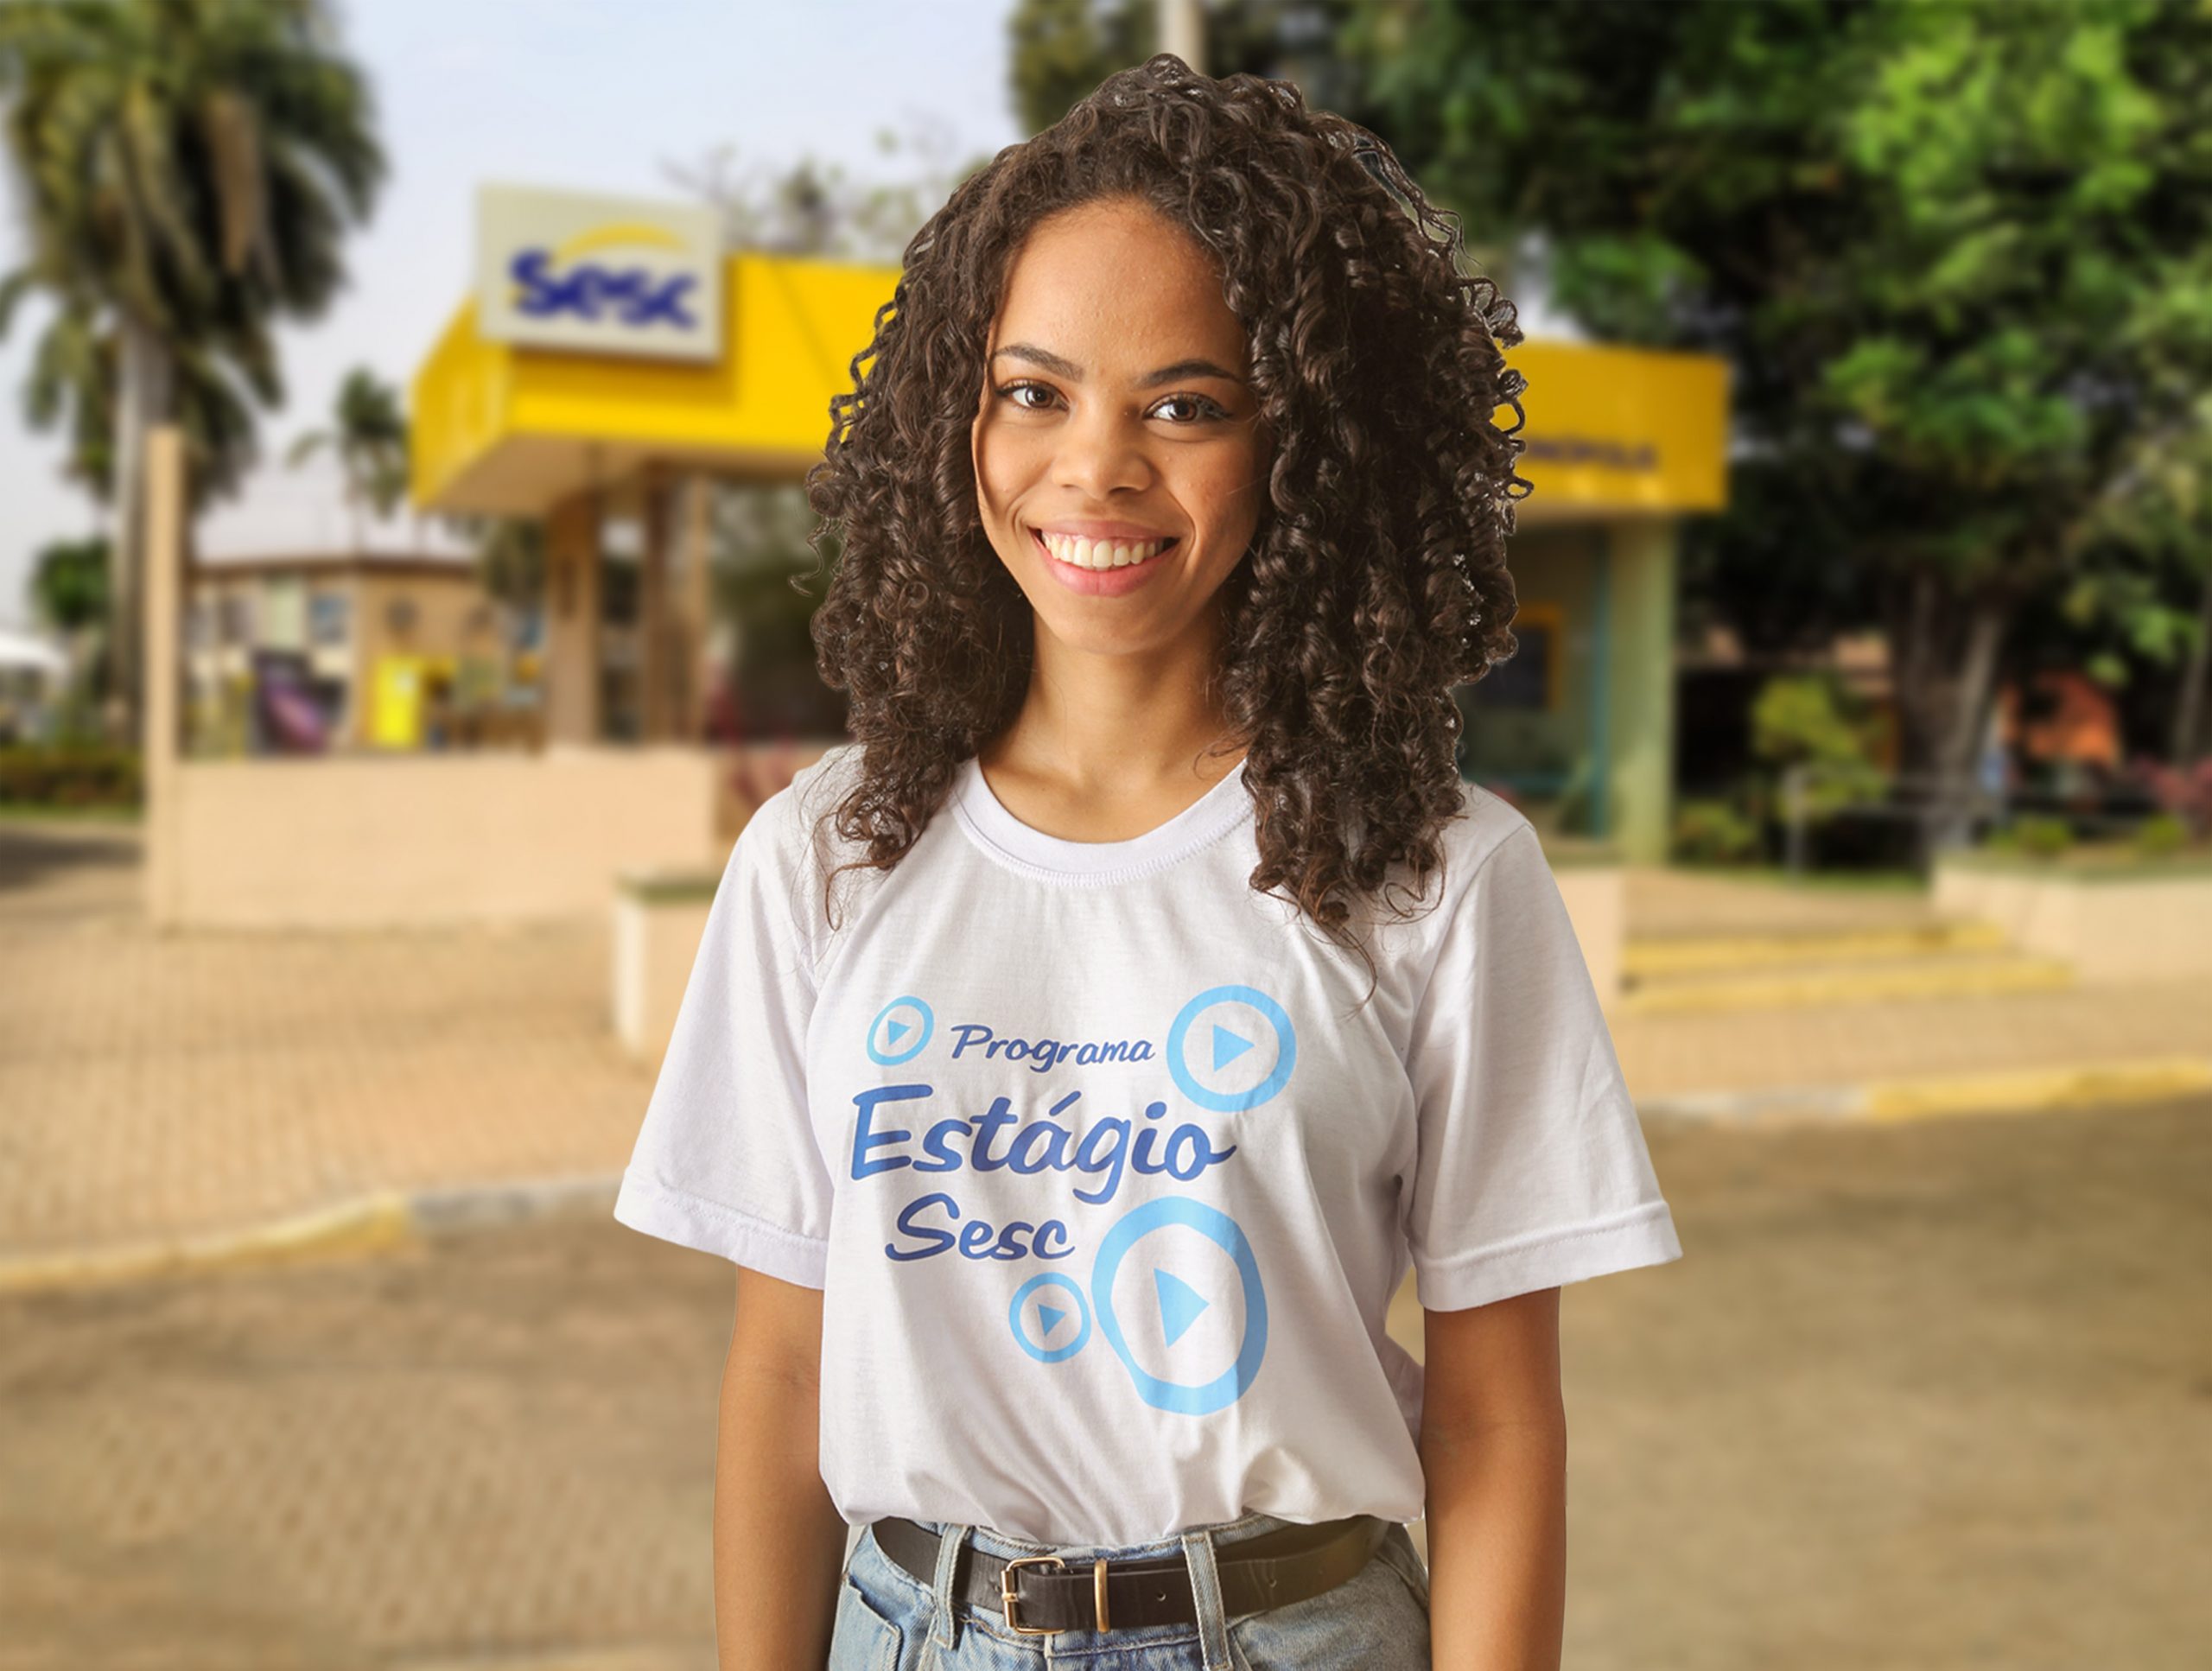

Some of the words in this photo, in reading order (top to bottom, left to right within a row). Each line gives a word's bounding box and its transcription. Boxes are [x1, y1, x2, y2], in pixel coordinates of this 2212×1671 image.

[510, 247, 698, 331] Sesc
[951, 1025, 1154, 1072] Programa
[851, 1084, 1236, 1204] Estágio
[886, 1192, 1075, 1261] Sesc
